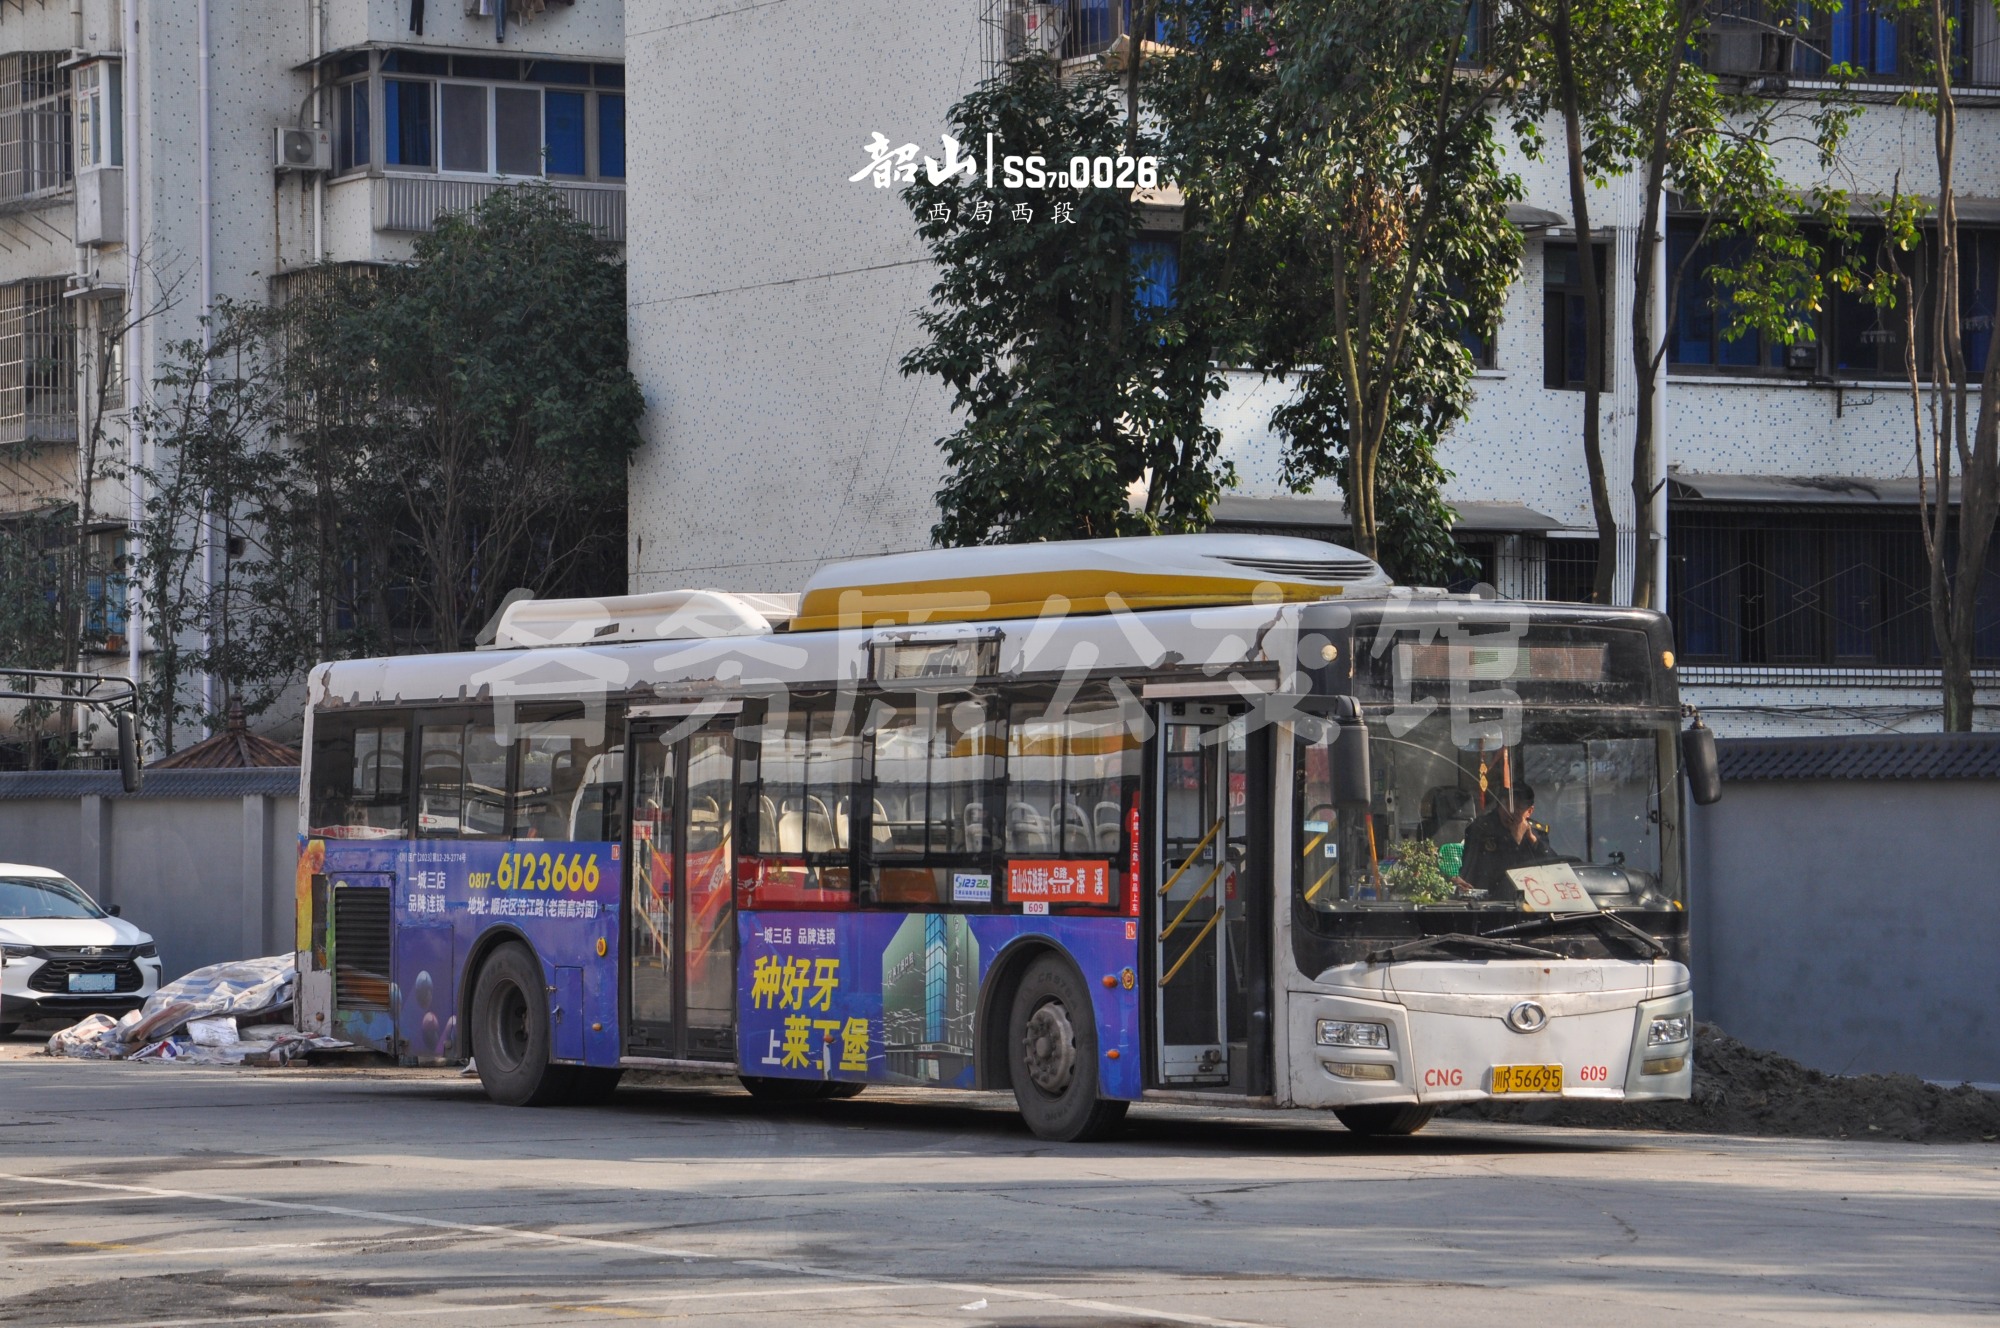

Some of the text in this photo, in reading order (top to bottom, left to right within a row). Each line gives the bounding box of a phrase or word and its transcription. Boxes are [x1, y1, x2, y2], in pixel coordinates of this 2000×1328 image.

[408, 871, 446, 890] 一城三店
[469, 852, 600, 892] 0817-6123666
[1053, 867, 1067, 879] 6路
[1522, 877, 1551, 906] 6
[408, 894, 445, 913] 品牌连锁
[1028, 903, 1044, 913] 609
[755, 927, 836, 945] 一城三店 品牌连锁
[752, 955, 840, 1012] 种好牙
[1424, 1068, 1463, 1087] CNG
[1580, 1066, 1607, 1081] 609
